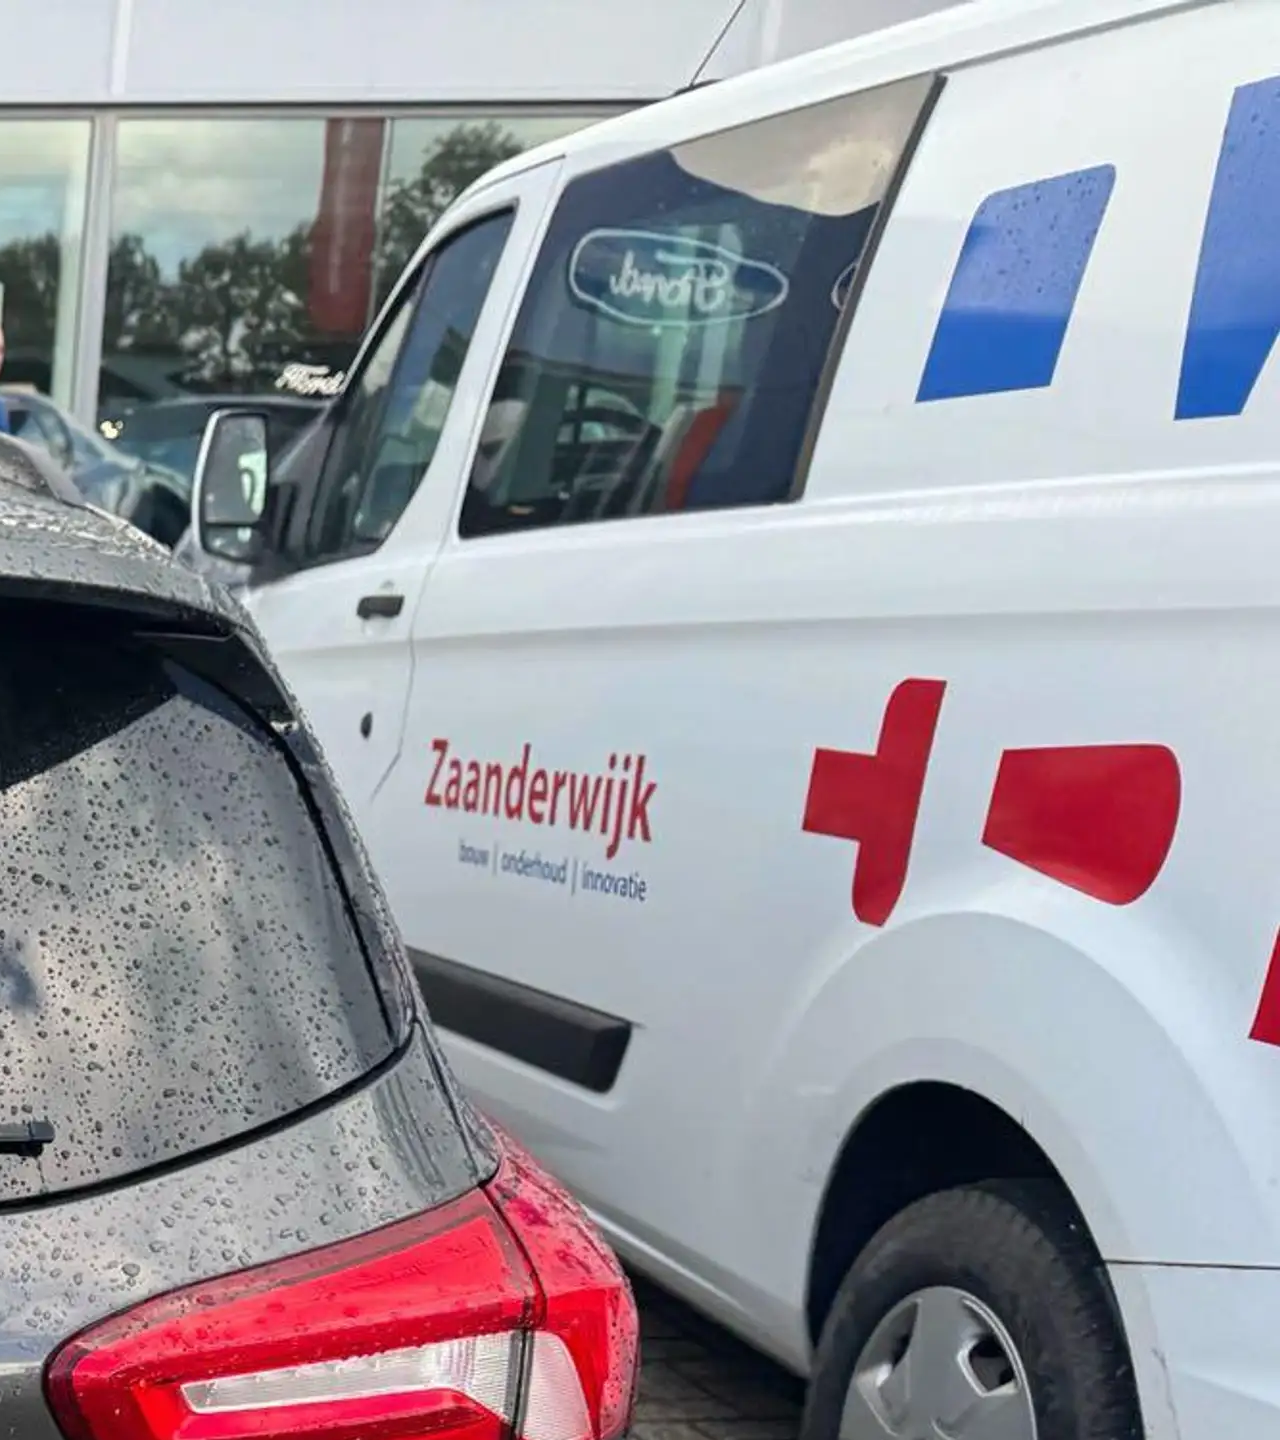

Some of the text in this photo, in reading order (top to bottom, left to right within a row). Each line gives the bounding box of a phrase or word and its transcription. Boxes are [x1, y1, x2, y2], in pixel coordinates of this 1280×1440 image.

[274, 363, 345, 396] Ford
[424, 738, 657, 861] Zaanderwijk
[458, 839, 647, 902] bouw onderhoud innovatie
